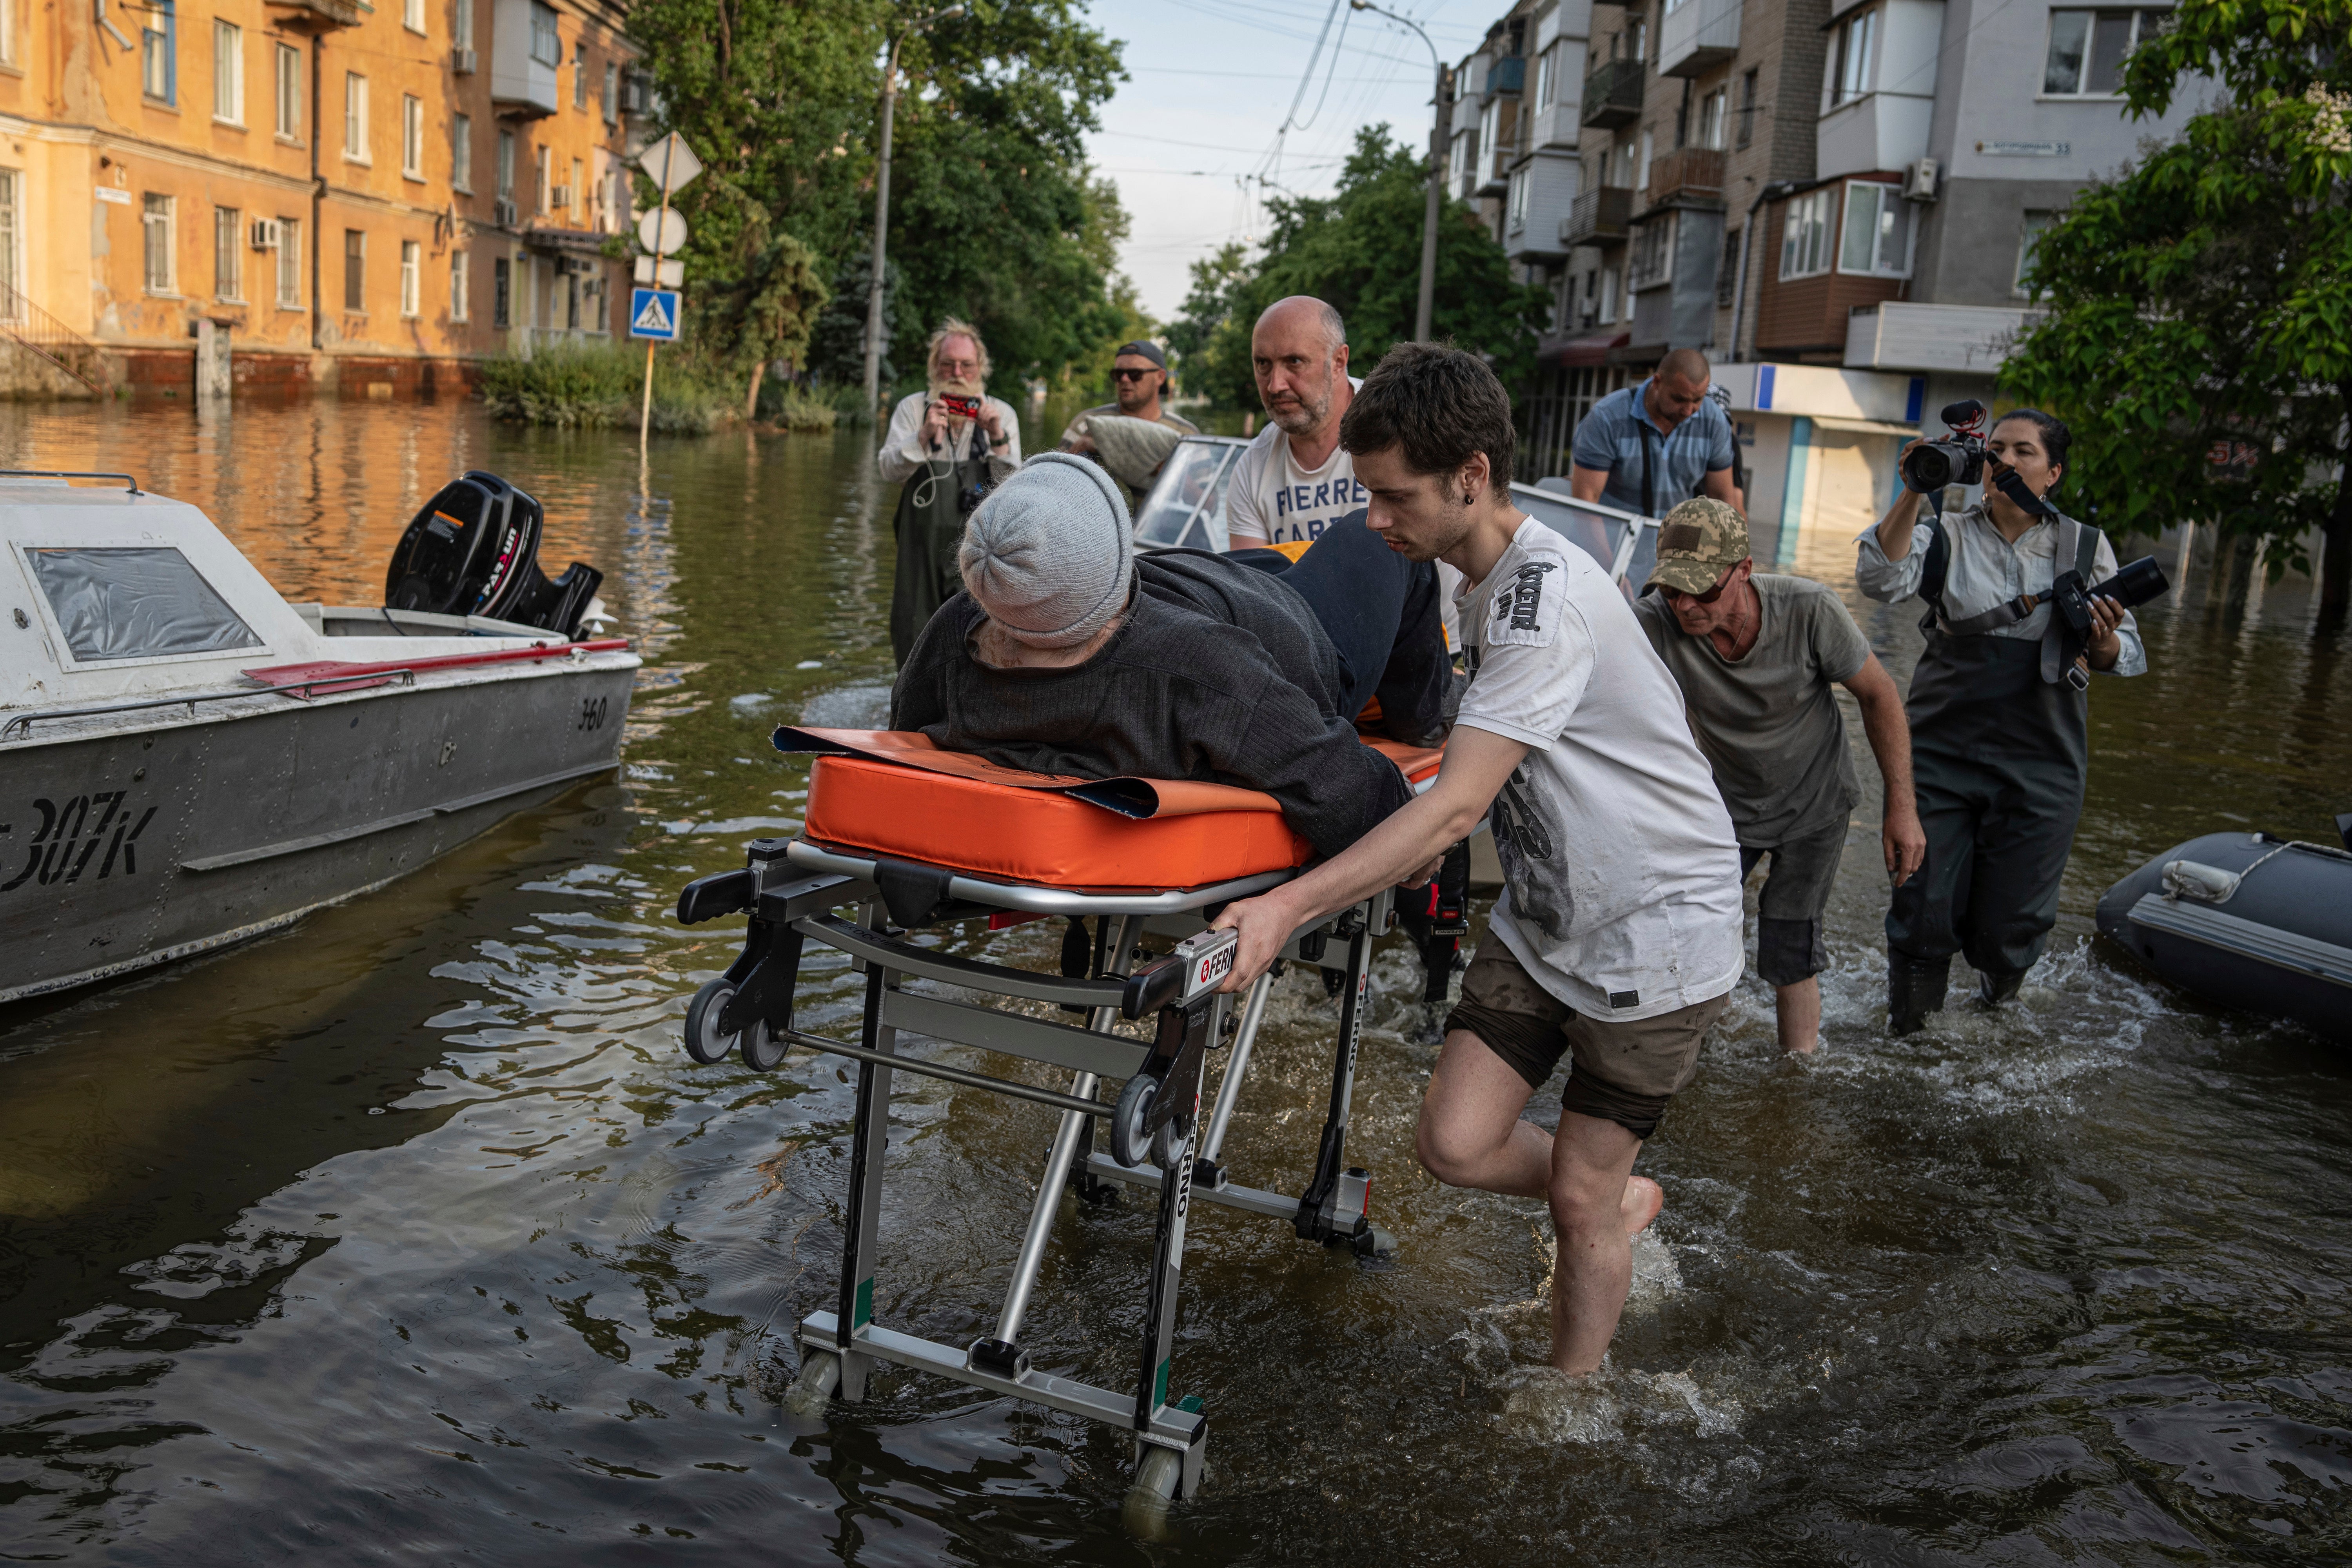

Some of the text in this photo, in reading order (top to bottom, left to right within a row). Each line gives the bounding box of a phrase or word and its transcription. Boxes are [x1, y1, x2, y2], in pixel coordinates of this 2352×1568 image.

[1277, 476, 1367, 516] PIERRE
[1275, 516, 1343, 544] CAR
[481, 527, 517, 597] PARSUN
[1349, 995, 1363, 1072] FERNO
